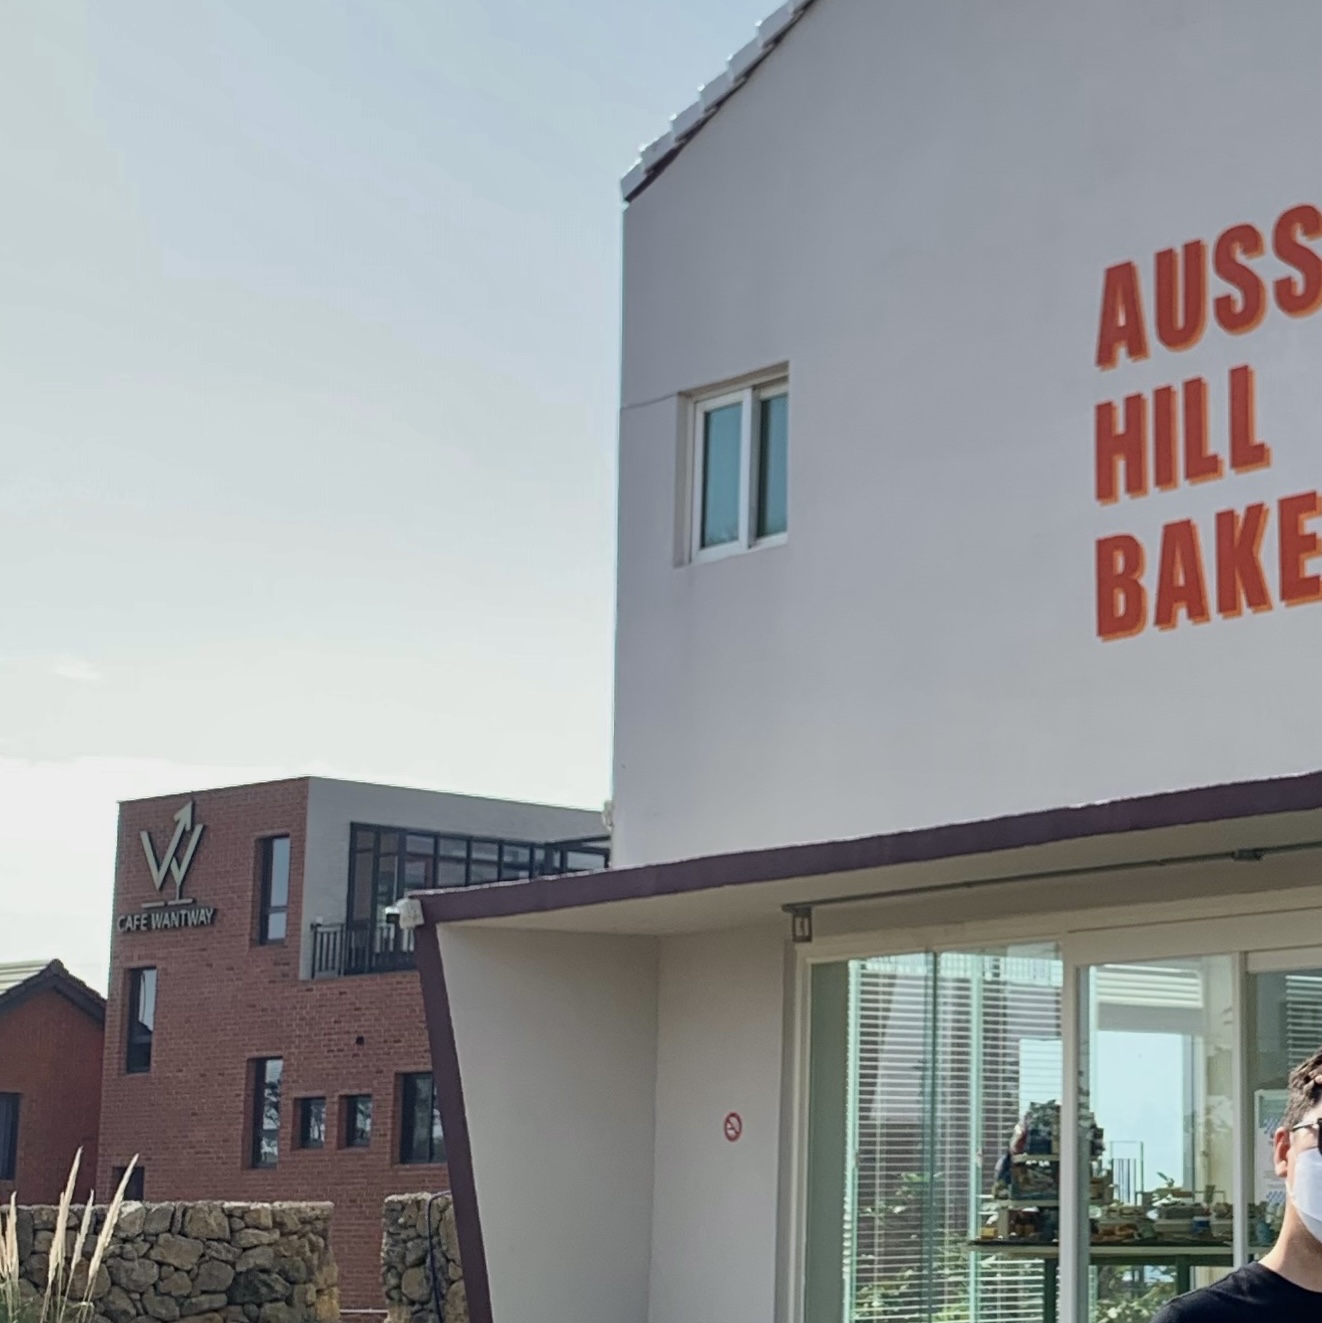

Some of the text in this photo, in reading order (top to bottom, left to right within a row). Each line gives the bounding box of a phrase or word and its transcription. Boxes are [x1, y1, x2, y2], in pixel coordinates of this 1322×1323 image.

[1095, 364, 1271, 506] HILL
[116, 906, 215, 933] CAFE WANTWAY
